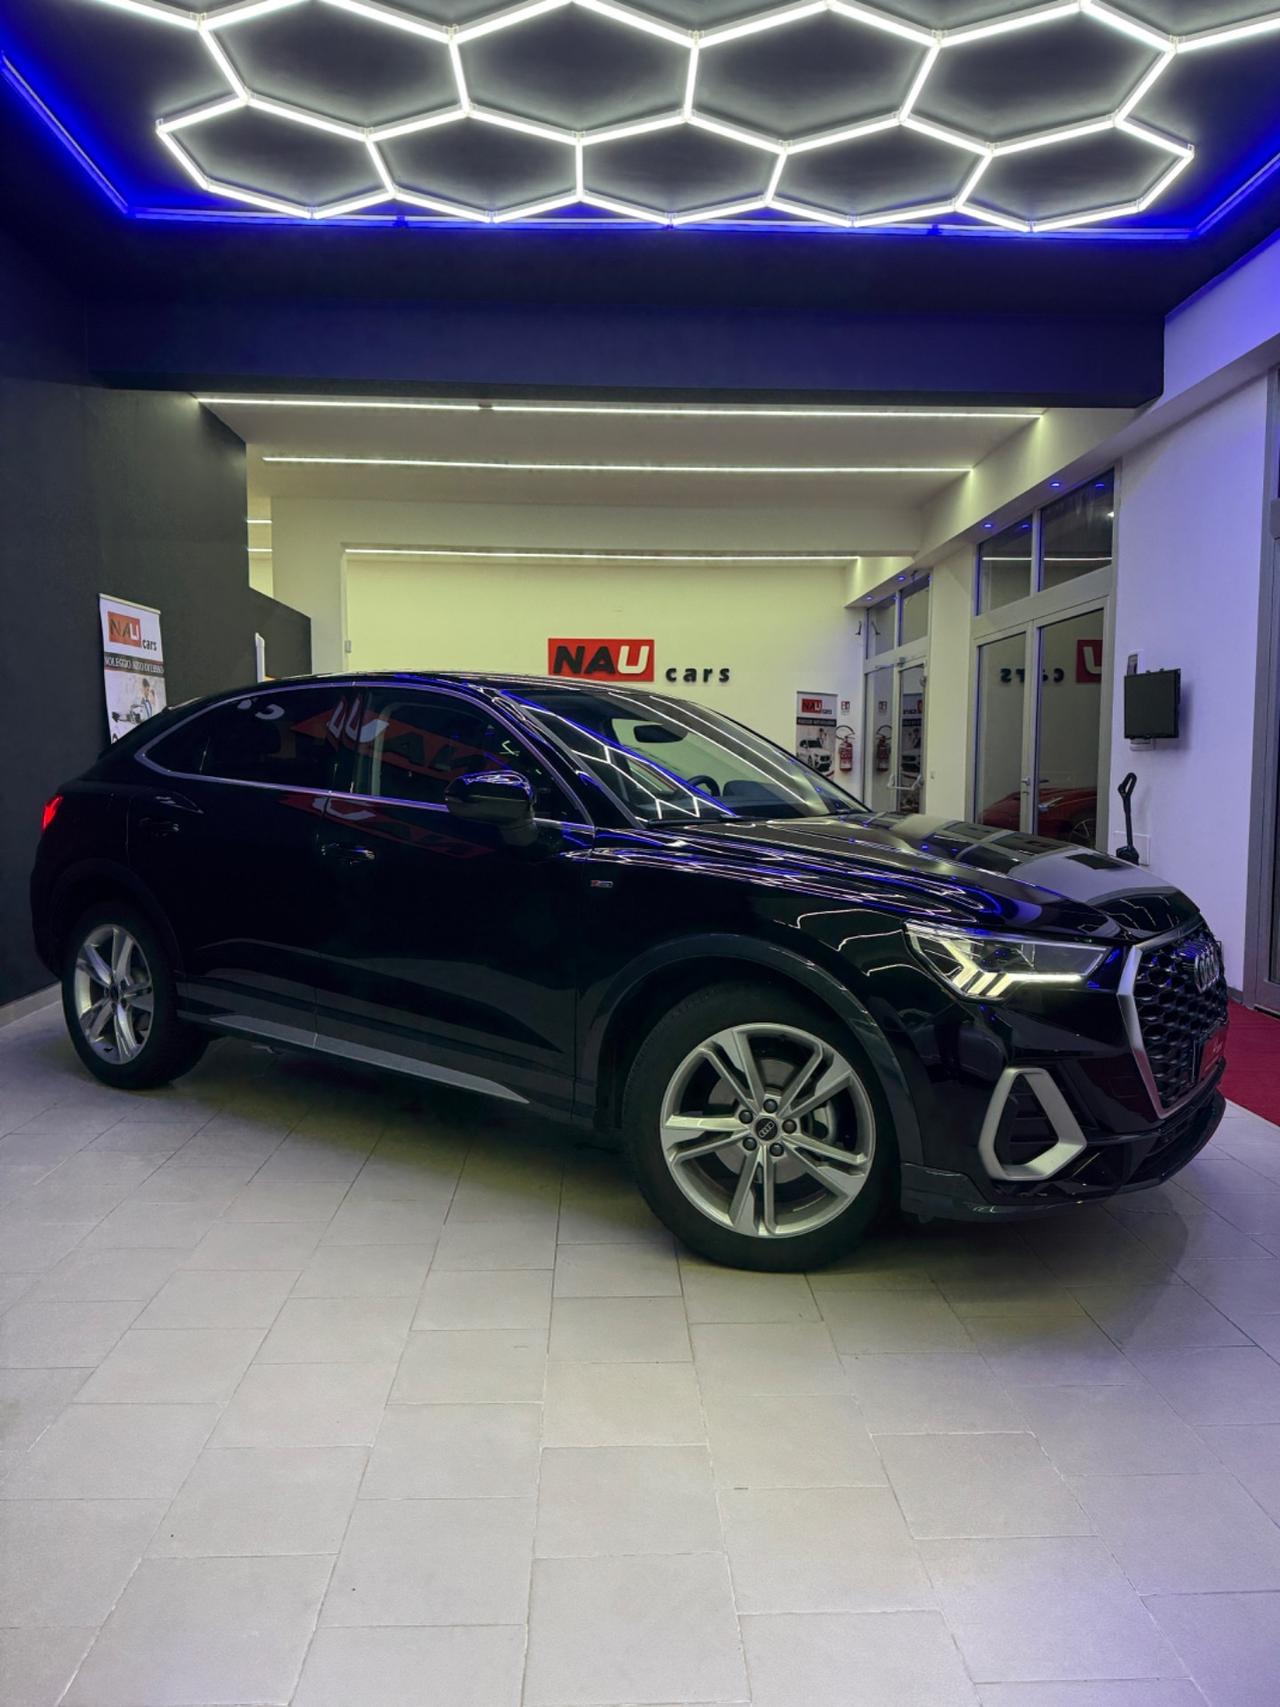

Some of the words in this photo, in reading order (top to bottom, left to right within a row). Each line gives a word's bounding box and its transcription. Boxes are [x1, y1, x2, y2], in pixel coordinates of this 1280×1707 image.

[110, 618, 139, 641] NAU
[142, 638, 157, 651] cars
[553, 645, 650, 675] NAU
[665, 667, 730, 683] cars
